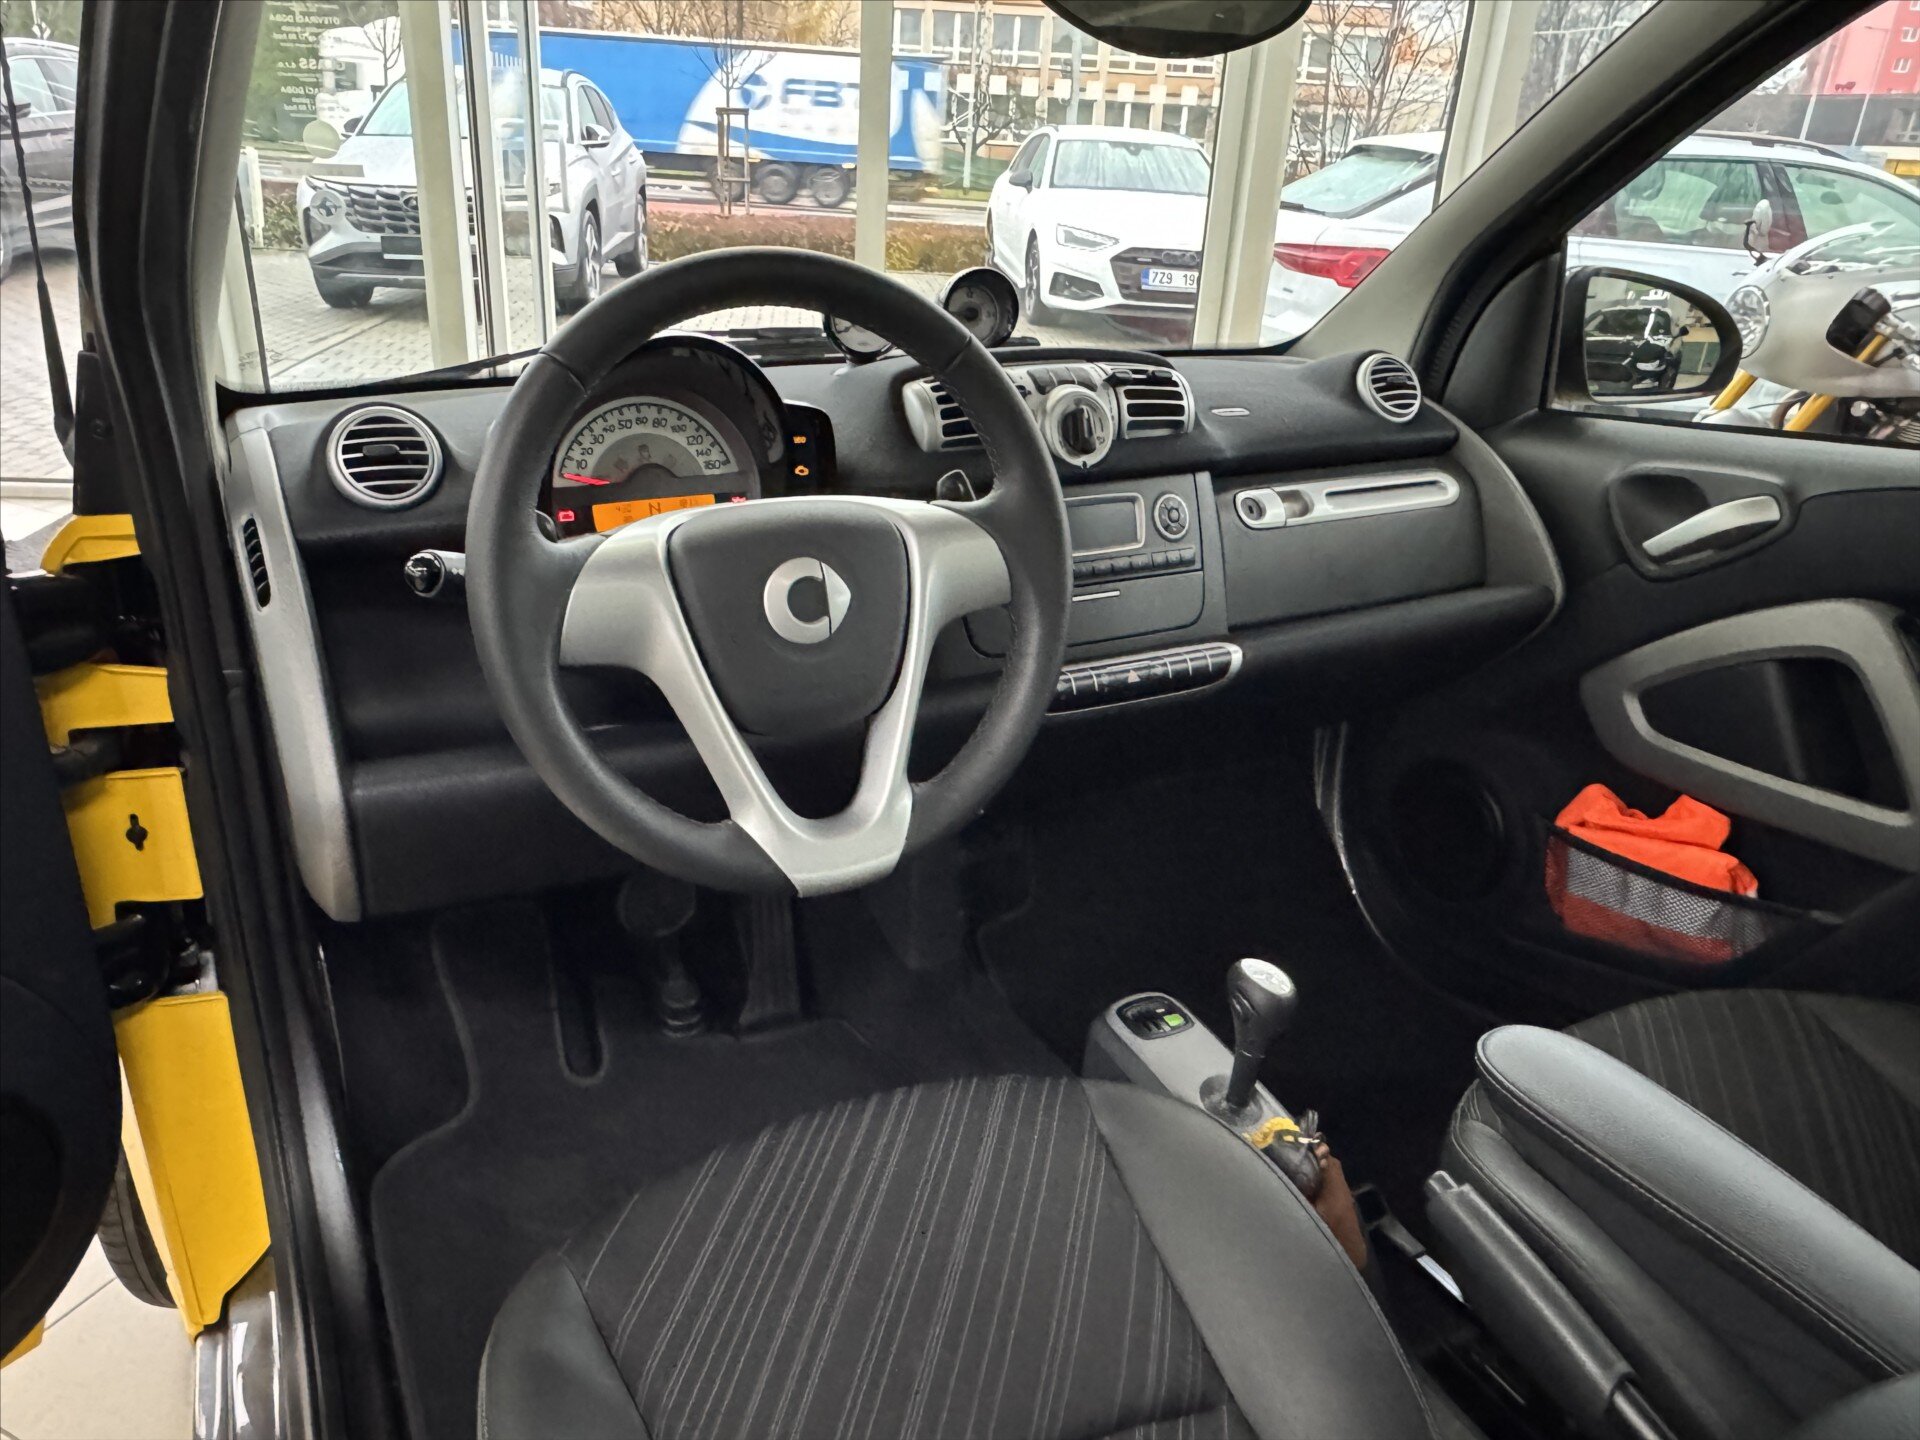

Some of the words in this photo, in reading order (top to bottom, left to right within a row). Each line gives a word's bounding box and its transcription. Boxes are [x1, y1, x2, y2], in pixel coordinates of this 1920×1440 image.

[1152, 271, 1173, 285] 7Z9
[1182, 273, 1199, 286] 19
[617, 419, 633, 430] 50
[635, 416, 648, 425] 60
[652, 417, 668, 428] 80
[602, 424, 616, 433] 40
[671, 424, 687, 433] 100
[590, 434, 605, 445] 30
[686, 434, 703, 446] 120
[580, 447, 593, 456] 20
[695, 448, 712, 458] 140
[575, 459, 588, 470] 10
[703, 459, 721, 471] 160
[648, 501, 662, 515] N
